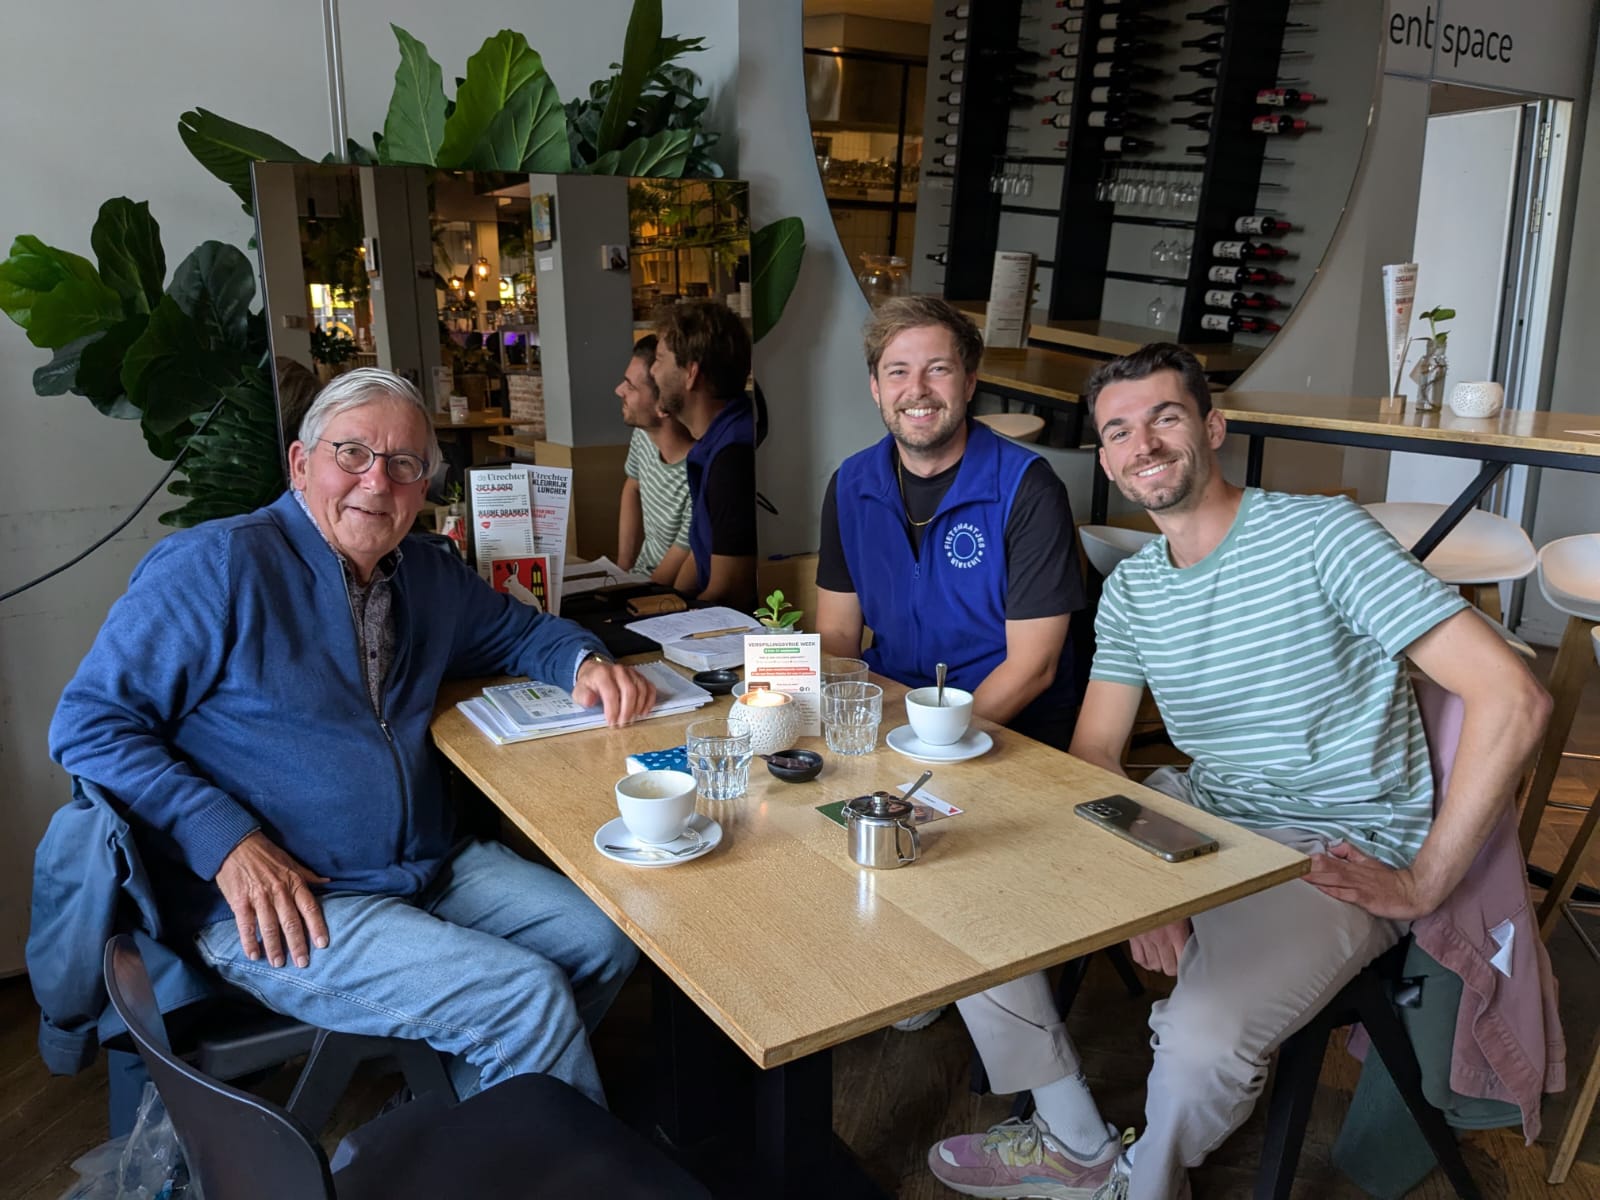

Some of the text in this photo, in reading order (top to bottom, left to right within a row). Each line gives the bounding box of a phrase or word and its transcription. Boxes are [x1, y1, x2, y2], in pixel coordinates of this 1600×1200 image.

[1390, 5, 1513, 68] ent space
[532, 479, 567, 489] KLEURRIJK
[537, 487, 567, 495] LUNCHEN
[944, 523, 985, 549] FIETSMAATJES
[950, 557, 981, 568] UTRECHT
